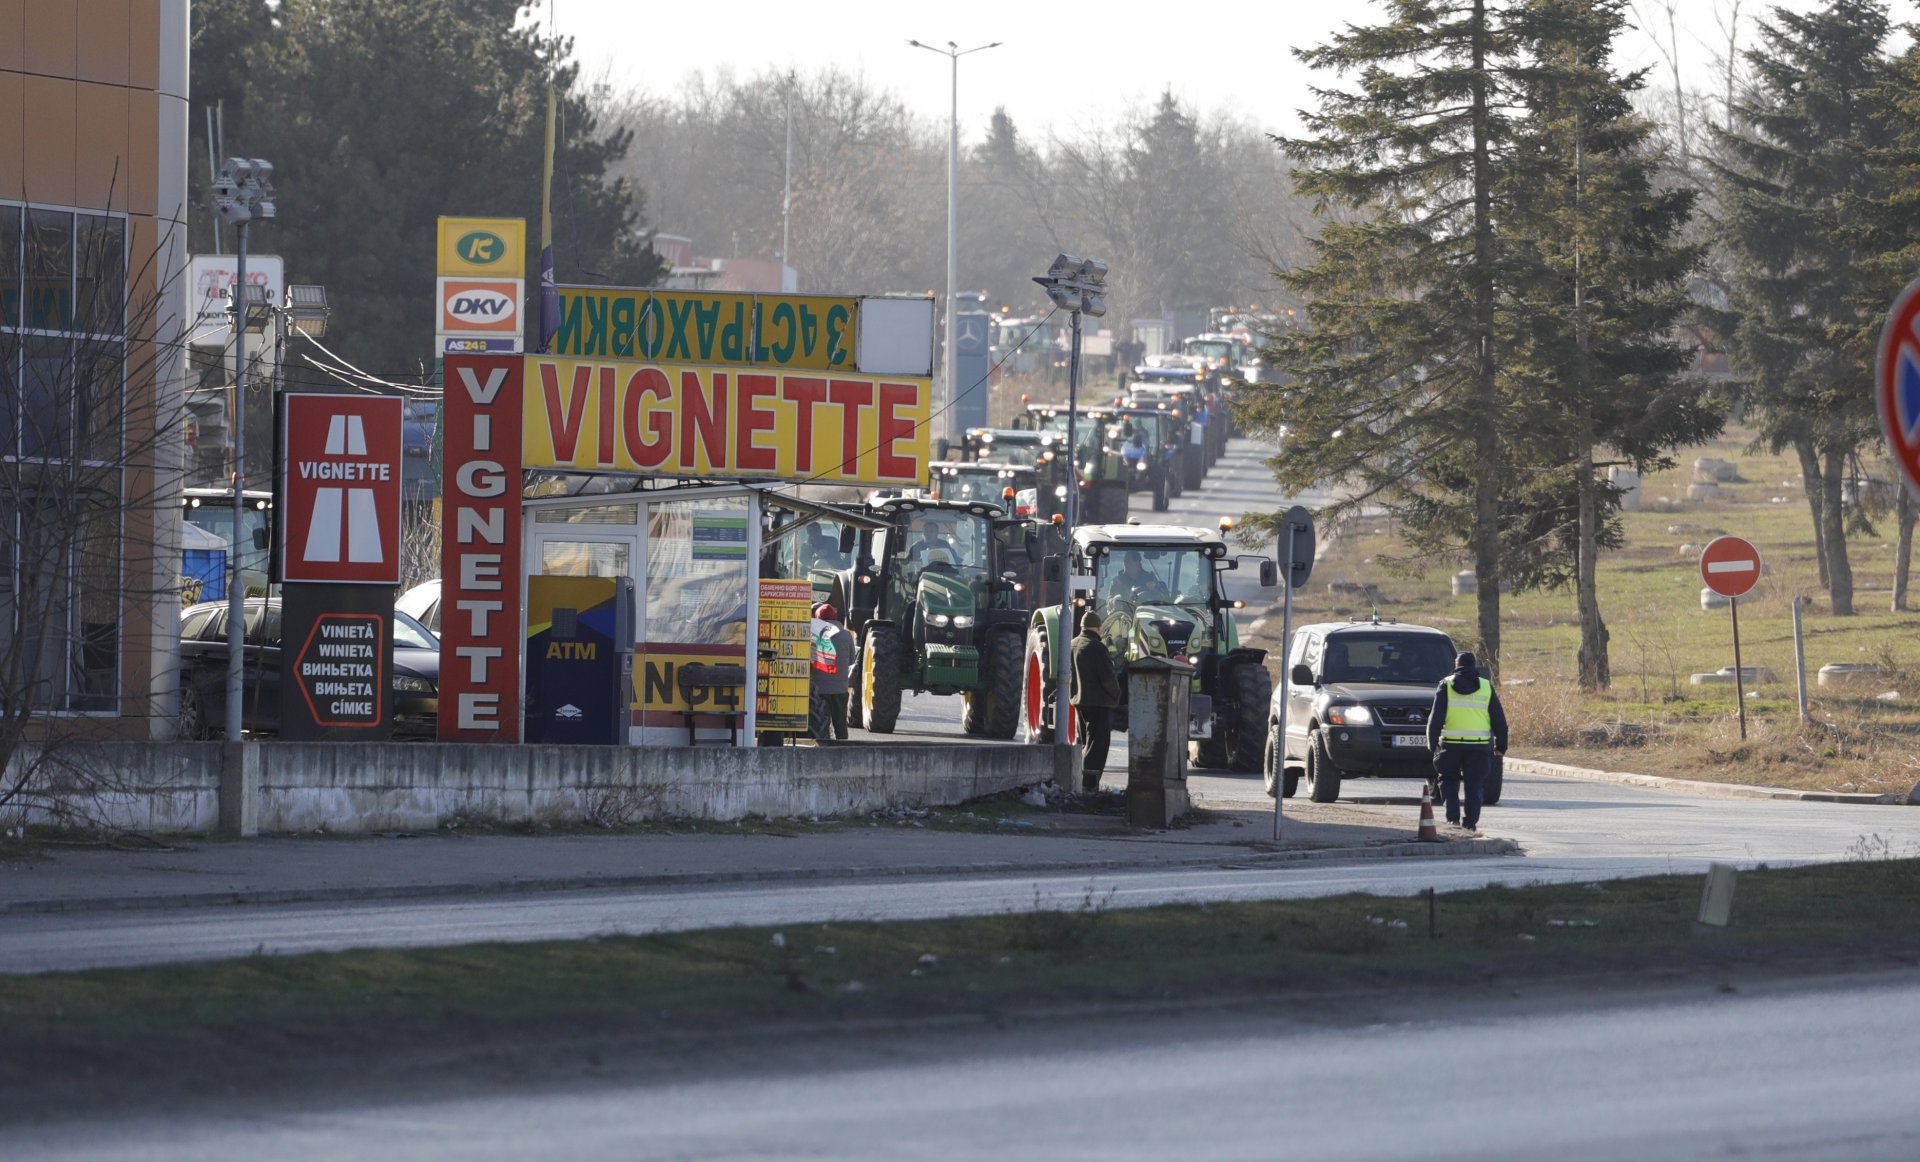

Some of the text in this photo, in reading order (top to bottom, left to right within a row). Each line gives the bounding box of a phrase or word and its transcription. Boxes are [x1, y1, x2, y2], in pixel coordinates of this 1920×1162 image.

[452, 298, 509, 315] DKV
[448, 340, 480, 350] AS24
[538, 362, 919, 480] VIGNETTE
[299, 461, 390, 481] VIGNETTE
[456, 367, 508, 730] VIGNETTE
[321, 623, 374, 639] VINIETĂ
[760, 623, 770, 637] EUR
[319, 644, 373, 657] WINIETA
[546, 641, 596, 660] ATM
[302, 663, 373, 676] ВИНЬЕТКА
[315, 682, 373, 696] ВИЊЕТА
[632, 662, 740, 705] NGE
[331, 699, 372, 715] CÍMKE
[1400, 736, 1406, 744] P
